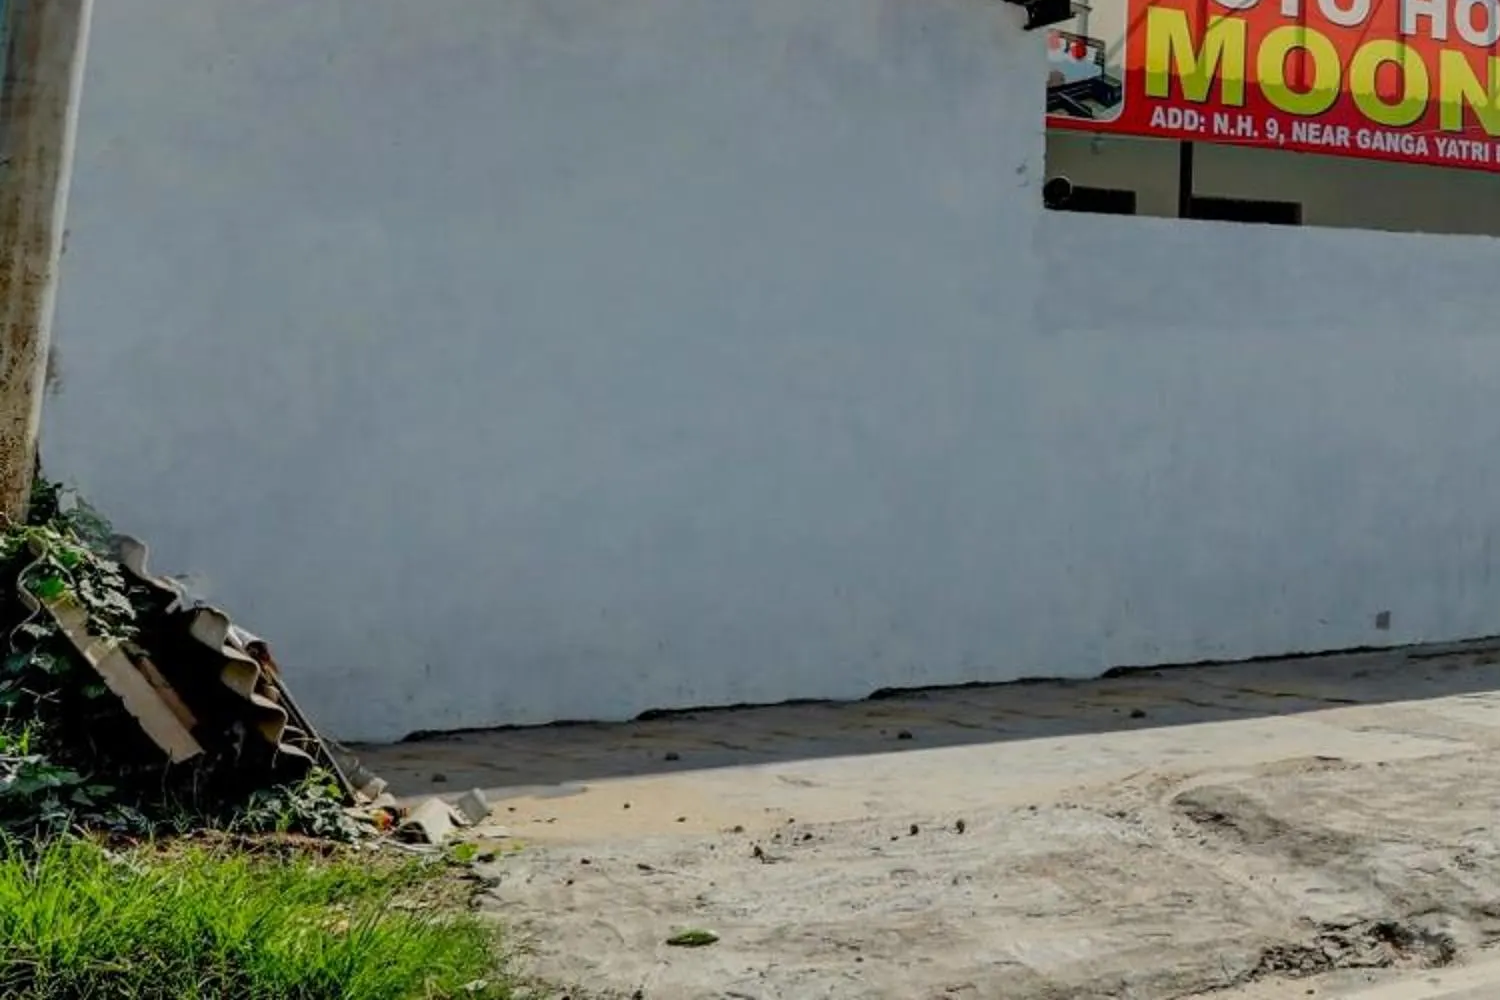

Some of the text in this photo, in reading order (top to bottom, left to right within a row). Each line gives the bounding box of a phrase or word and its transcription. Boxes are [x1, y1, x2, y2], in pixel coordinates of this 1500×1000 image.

[1150, 105, 1206, 134] ADD:
[1212, 112, 1260, 138] N.H.
[1265, 117, 1286, 145] 9,
[1291, 120, 1351, 148] NEAR
[1356, 128, 1430, 157] GANGA
[1435, 137, 1490, 164] YATRI
